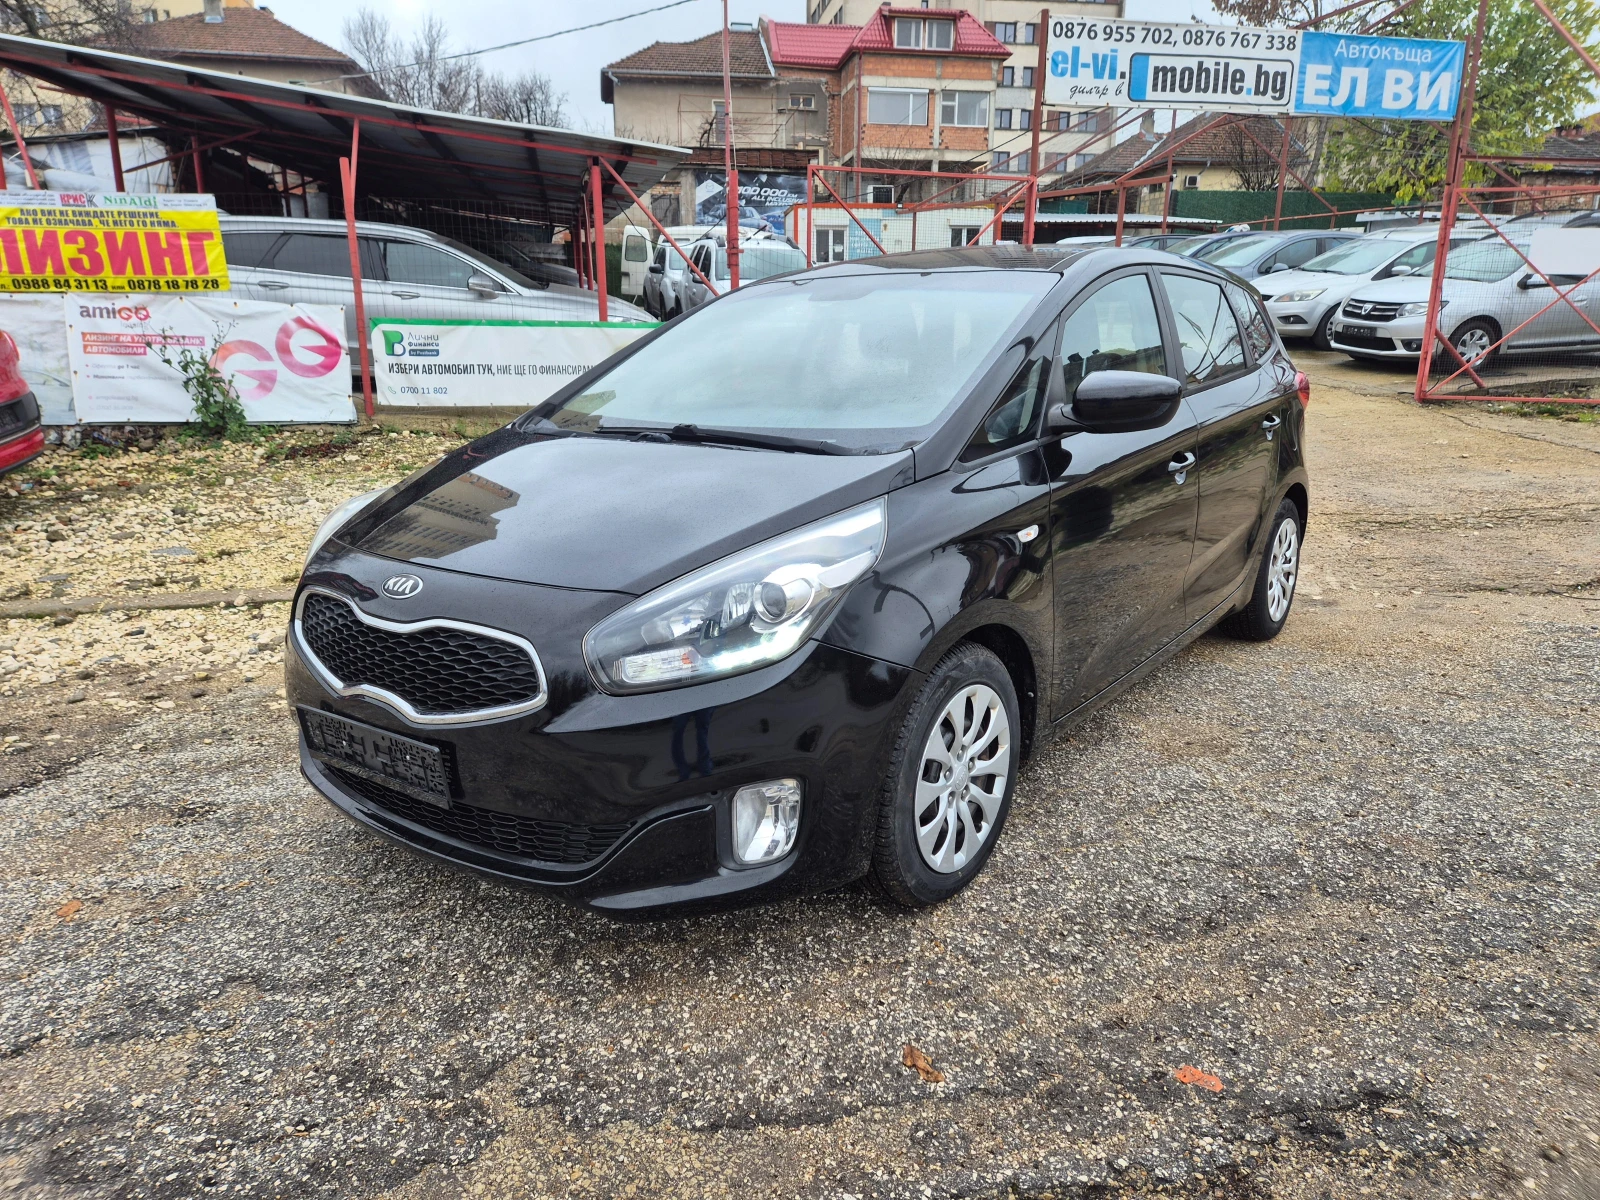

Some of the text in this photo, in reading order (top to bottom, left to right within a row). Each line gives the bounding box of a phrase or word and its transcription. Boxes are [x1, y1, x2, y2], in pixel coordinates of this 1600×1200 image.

[1052, 21, 1297, 51] 0876 955 702, 0876 767 338
[1334, 39, 1432, 65] Автокъща
[1151, 60, 1287, 101] mobile.bg
[1302, 63, 1452, 111] ЕЛ ВИ
[1069, 81, 1125, 99] дилър в
[760, 187, 788, 197] 000
[20, 208, 38, 217] АКО
[40, 209, 57, 218] ВИЕ
[59, 209, 70, 218] НЕ
[72, 209, 115, 220] ВИЖДАТЕ
[6, 217, 30, 226] ТОВА
[32, 217, 44, 226] НЕ
[99, 219, 110, 227] ЧЕ
[112, 219, 135, 227] НЕГО
[137, 219, 147, 228] ГО
[0, 229, 214, 277] ЛИЗИНГ
[11, 278, 51, 290] 0988
[53, 278, 72, 290] 84
[73, 278, 90, 290] 31
[92, 279, 108, 290] 13
[127, 279, 161, 290] 0878
[164, 279, 180, 290] 18
[182, 279, 199, 290] 78
[202, 278, 219, 290] 28
[85, 333, 119, 342] ЛИЗИНГ
[120, 334, 132, 342] НА
[408, 332, 439, 341] Лични
[86, 345, 145, 354] АВТОМОБИЛИ
[388, 362, 420, 375] ИЗБЕРИ
[421, 363, 475, 375] АВТОМОБИЛ
[477, 363, 495, 376] ТУК,
[496, 364, 512, 375] НИЕ
[514, 364, 527, 376] ЩЕ
[528, 364, 538, 375] ГО
[400, 386, 419, 394] 0700
[433, 386, 448, 394] 802
[384, 576, 415, 594] KIA
